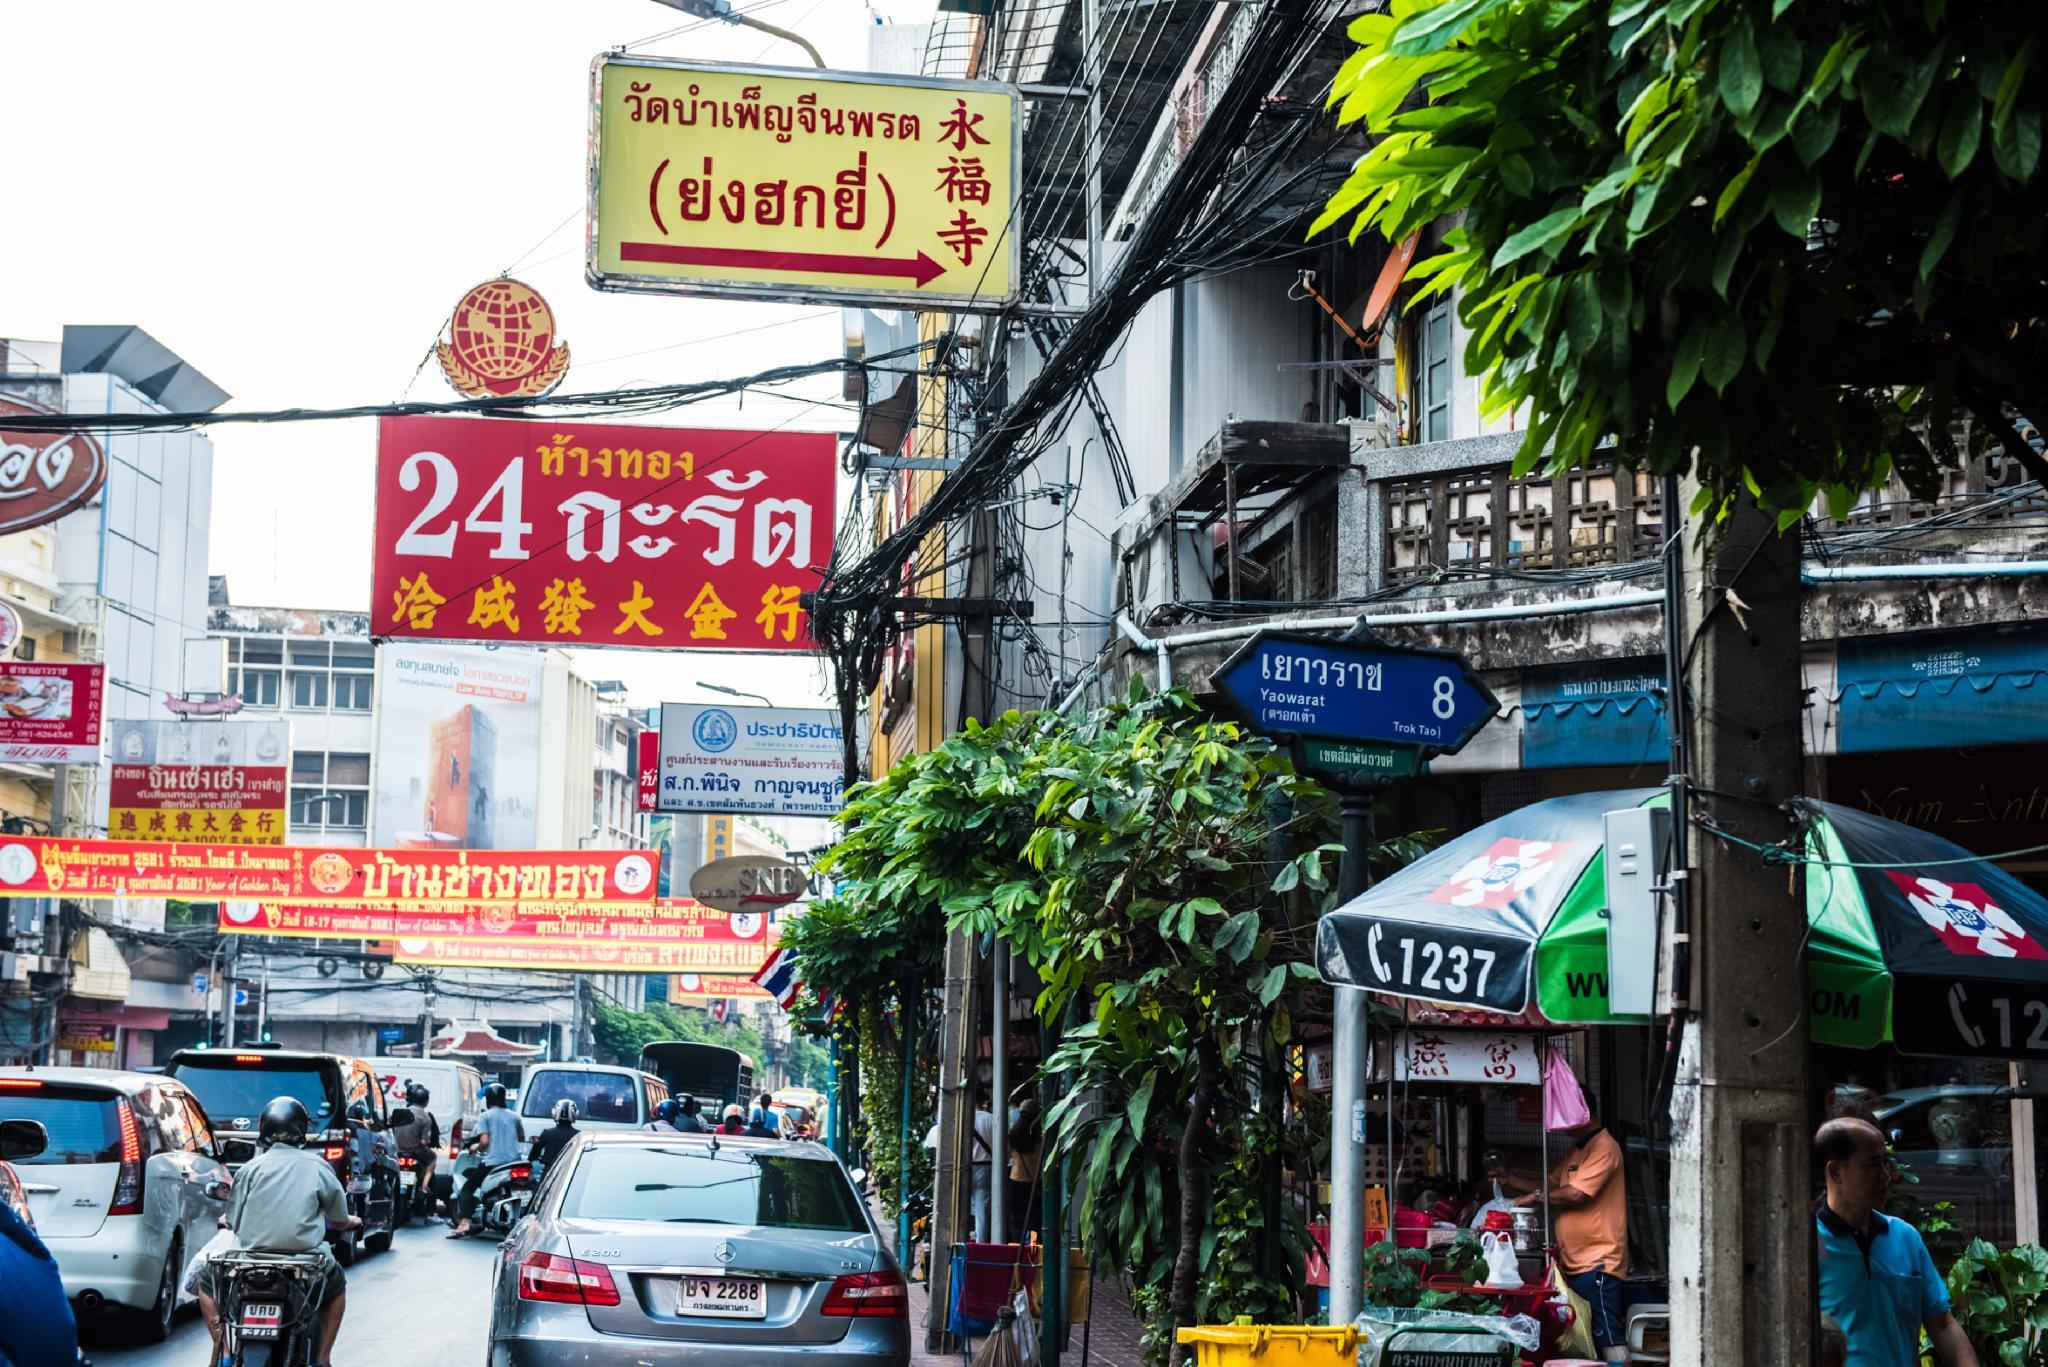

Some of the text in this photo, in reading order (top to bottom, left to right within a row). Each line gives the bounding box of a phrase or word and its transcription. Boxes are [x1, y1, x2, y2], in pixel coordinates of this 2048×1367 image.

[624, 81, 920, 143] วัดบำเพ็ญจีนพรต
[650, 151, 896, 249] (ย่งฮกยี่)
[934, 98, 991, 267] 永福寺
[536, 433, 695, 481] ห้างทอง
[395, 451, 812, 568] 24 กะรัต
[1261, 653, 1382, 692] เยาวราช
[1261, 688, 1325, 707] Yaowarat
[1432, 676, 1455, 719] 8
[1393, 722, 1416, 734] Trok
[1319, 745, 1395, 768] เขตสัมพันธวงศ์
[205, 877, 226, 894] Year
[228, 876, 238, 897] of
[239, 877, 269, 892] Golden
[272, 878, 290, 896] Dog
[363, 851, 606, 899] บ้านช่างทอง
[1401, 938, 1496, 998] 1237
[693, 1303, 749, 1312] กรุงเทพมหานคร
[717, 1282, 758, 1300] 2288
